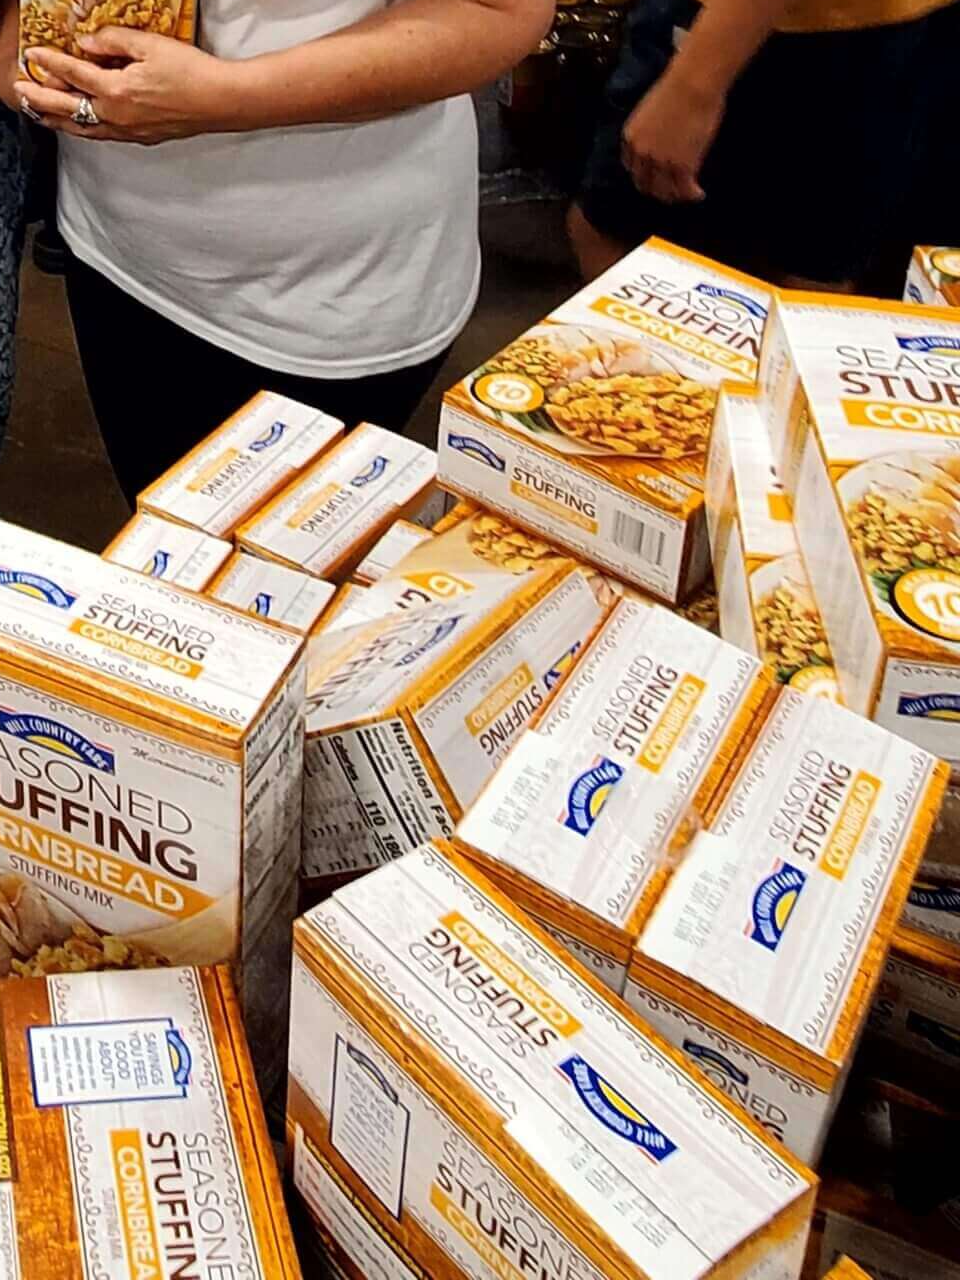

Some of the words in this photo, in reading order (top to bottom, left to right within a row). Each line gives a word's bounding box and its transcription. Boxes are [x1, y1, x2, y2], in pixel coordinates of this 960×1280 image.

[606, 304, 755, 377] CORNBREA
[613, 285, 760, 358] STUFFIN
[634, 273, 760, 336] SEASON
[200, 453, 252, 498] STUFFING
[300, 488, 353, 534] STUFFING
[513, 467, 596, 519] STUFFING
[517, 456, 597, 503] SEASONED
[79, 624, 192, 675] CORNBREAD
[83, 605, 207, 662] STUFFING
[96, 592, 215, 647] SEASONED
[6, 718, 29, 734] HILL
[28, 718, 81, 750] COUNTRY
[480, 685, 543, 757] STUFFING
[590, 655, 654, 742] SEASONED
[613, 665, 679, 758] STUFFING
[643, 680, 699, 765] CORNBREAD
[904, 698, 927, 713] HILL
[331, 734, 361, 782] Calories
[363, 798, 388, 828] 110
[380, 834, 403, 860] 180
[390, 720, 434, 799] Nutrition
[430, 805, 454, 842] Fac
[769, 749, 825, 842] SEASONED
[792, 760, 853, 862] STUFFING
[824, 780, 875, 871] CORNBREAD
[9, 853, 81, 896] STUFFING
[83, 884, 114, 911] MIX
[756, 880, 779, 919] COUNTRY
[407, 942, 537, 1059] SEASONED
[428, 927, 559, 1048] STUFFING
[450, 920, 570, 1028] CORNBREAD
[98, 1040, 116, 1089] ABOUT
[113, 1042, 131, 1080] GOOD
[143, 1032, 164, 1086] SAVINGS
[636, 1126, 667, 1150] HILL
[117, 1147, 155, 1280] CORNBREA
[147, 1131, 198, 1280] STUFFIN
[183, 1132, 233, 1280] SEASONE
[435, 1164, 547, 1280] STUFF
